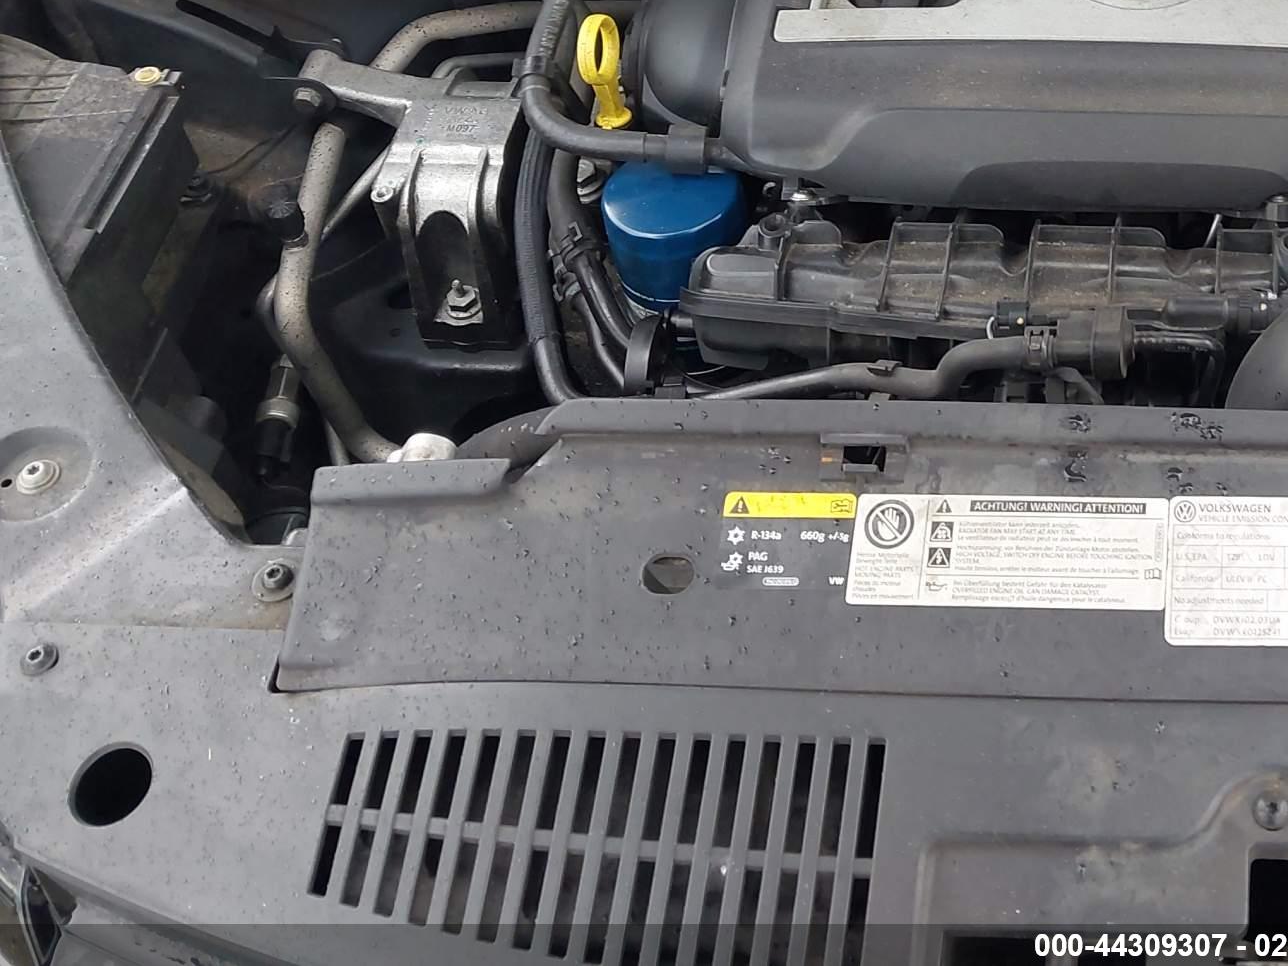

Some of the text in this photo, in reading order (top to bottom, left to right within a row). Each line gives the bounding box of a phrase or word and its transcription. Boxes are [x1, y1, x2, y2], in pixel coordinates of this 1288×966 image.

[974, 502, 1143, 513] ACHTUNG! WARNING! ATTENTION!
[1199, 503, 1271, 513] VOLKSWAGEN
[751, 530, 782, 540] R-134a
[800, 531, 825, 542] 660g
[748, 552, 768, 561] PAG
[746, 565, 784, 574] SAE J639
[829, 576, 844, 585] VW
